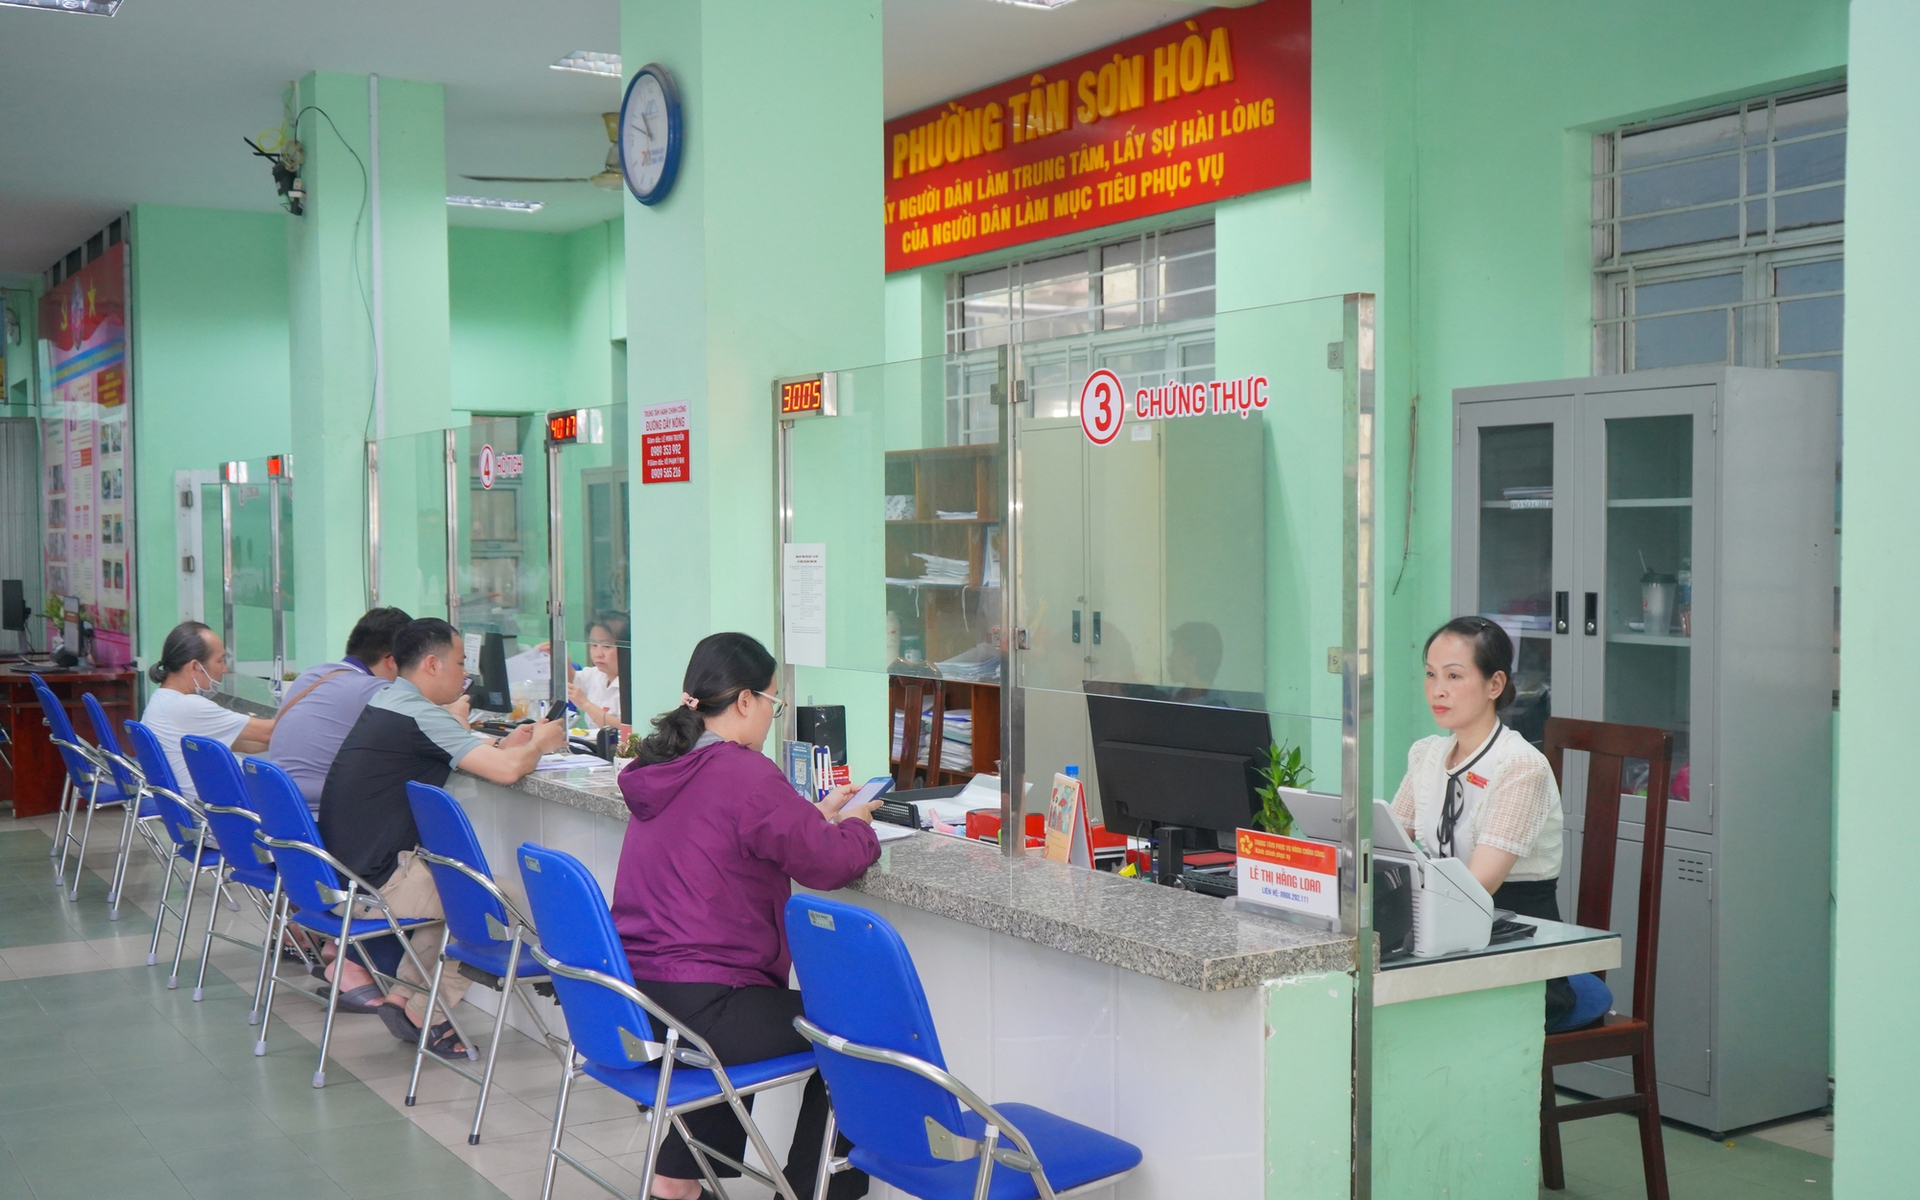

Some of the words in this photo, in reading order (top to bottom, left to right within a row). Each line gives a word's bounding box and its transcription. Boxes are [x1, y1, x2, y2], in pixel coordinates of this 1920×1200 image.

[893, 101, 1004, 179] PHƯỜNG
[1007, 74, 1070, 144] TÂN
[1077, 53, 1145, 124] SƠN
[1153, 20, 1234, 102] HÒA
[899, 184, 941, 221] NGƯỜI
[944, 178, 973, 209] DÂN
[977, 169, 1009, 200] LÀM
[1013, 155, 1066, 190] TRUNG
[1069, 143, 1110, 176] TÂM,
[1113, 124, 1146, 165] LẤY
[1151, 120, 1177, 158] SỰ
[1181, 110, 1214, 147] HÀI
[1221, 98, 1275, 136] LÒNG
[902, 221, 930, 254] CỦA
[932, 209, 977, 246] NGƯỜI
[981, 203, 1011, 235] DÂN
[1015, 196, 1049, 227] LÀM
[1054, 186, 1092, 220] MỤC
[1097, 172, 1136, 207] TIÊU
[1141, 161, 1192, 198] PHỤC
[1197, 152, 1224, 187] VỤ
[783, 381, 821, 412] 3005
[1094, 382, 1112, 432] 3
[1136, 380, 1206, 418] CHỨNG
[1210, 376, 1268, 417] THỰC
[551, 415, 577, 440] 4017
[484, 452, 490, 481] 4
[1250, 865, 1259, 880] LÊ
[1261, 868, 1274, 886] THỊ
[1276, 868, 1298, 888] HẰNG
[1300, 877, 1321, 893] LOAN
